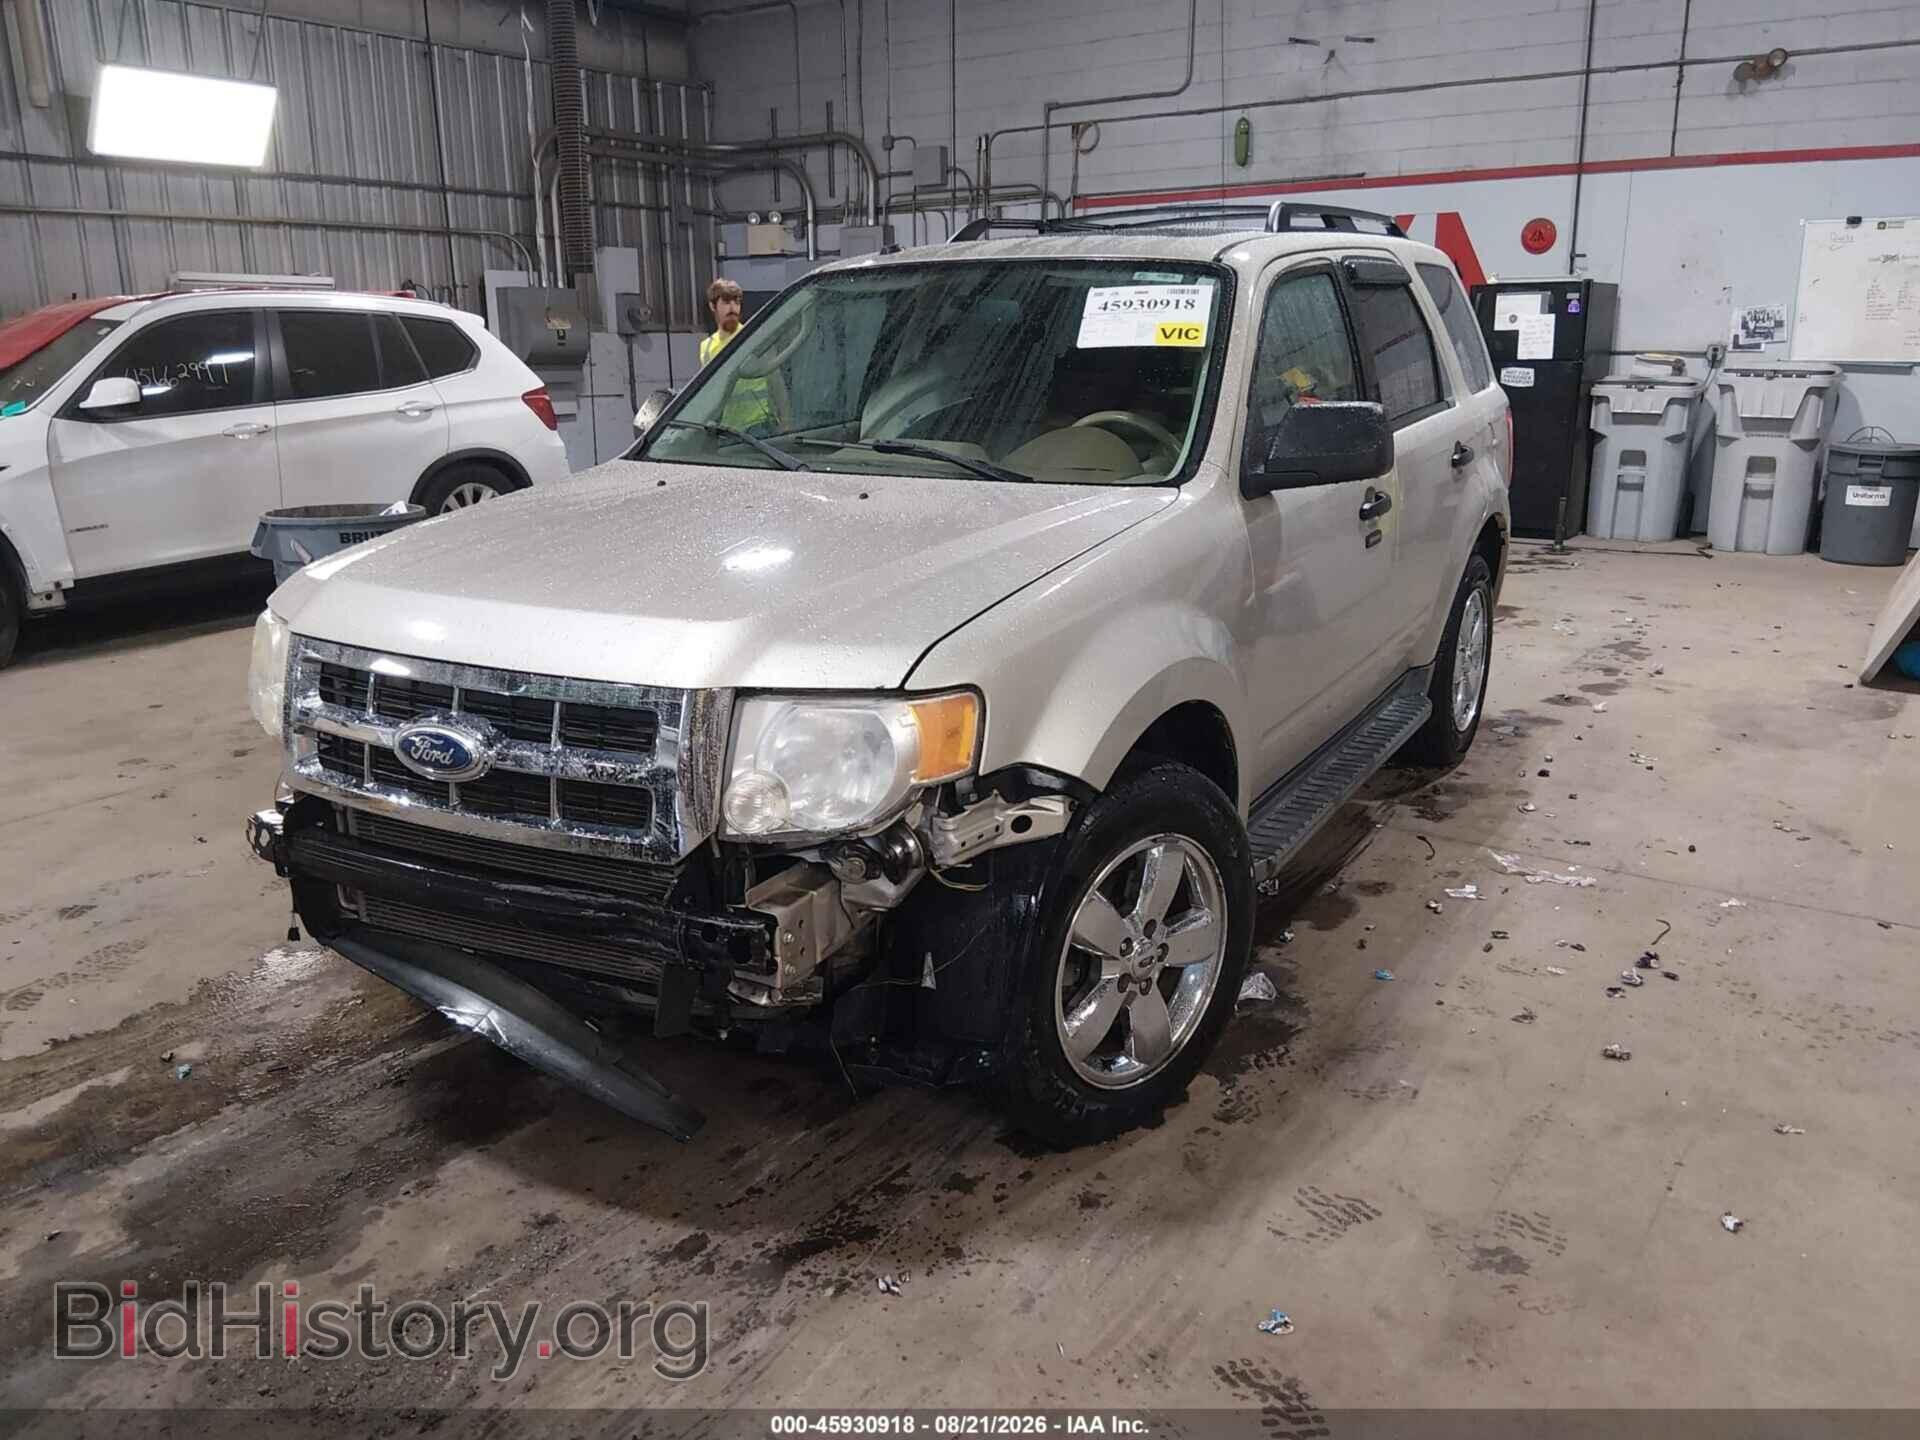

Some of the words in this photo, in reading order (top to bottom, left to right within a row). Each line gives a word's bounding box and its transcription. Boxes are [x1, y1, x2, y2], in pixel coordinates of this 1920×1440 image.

[1098, 298, 1195, 311] 45930918
[1160, 327, 1200, 340] VIC
[408, 735, 454, 765] Ford
